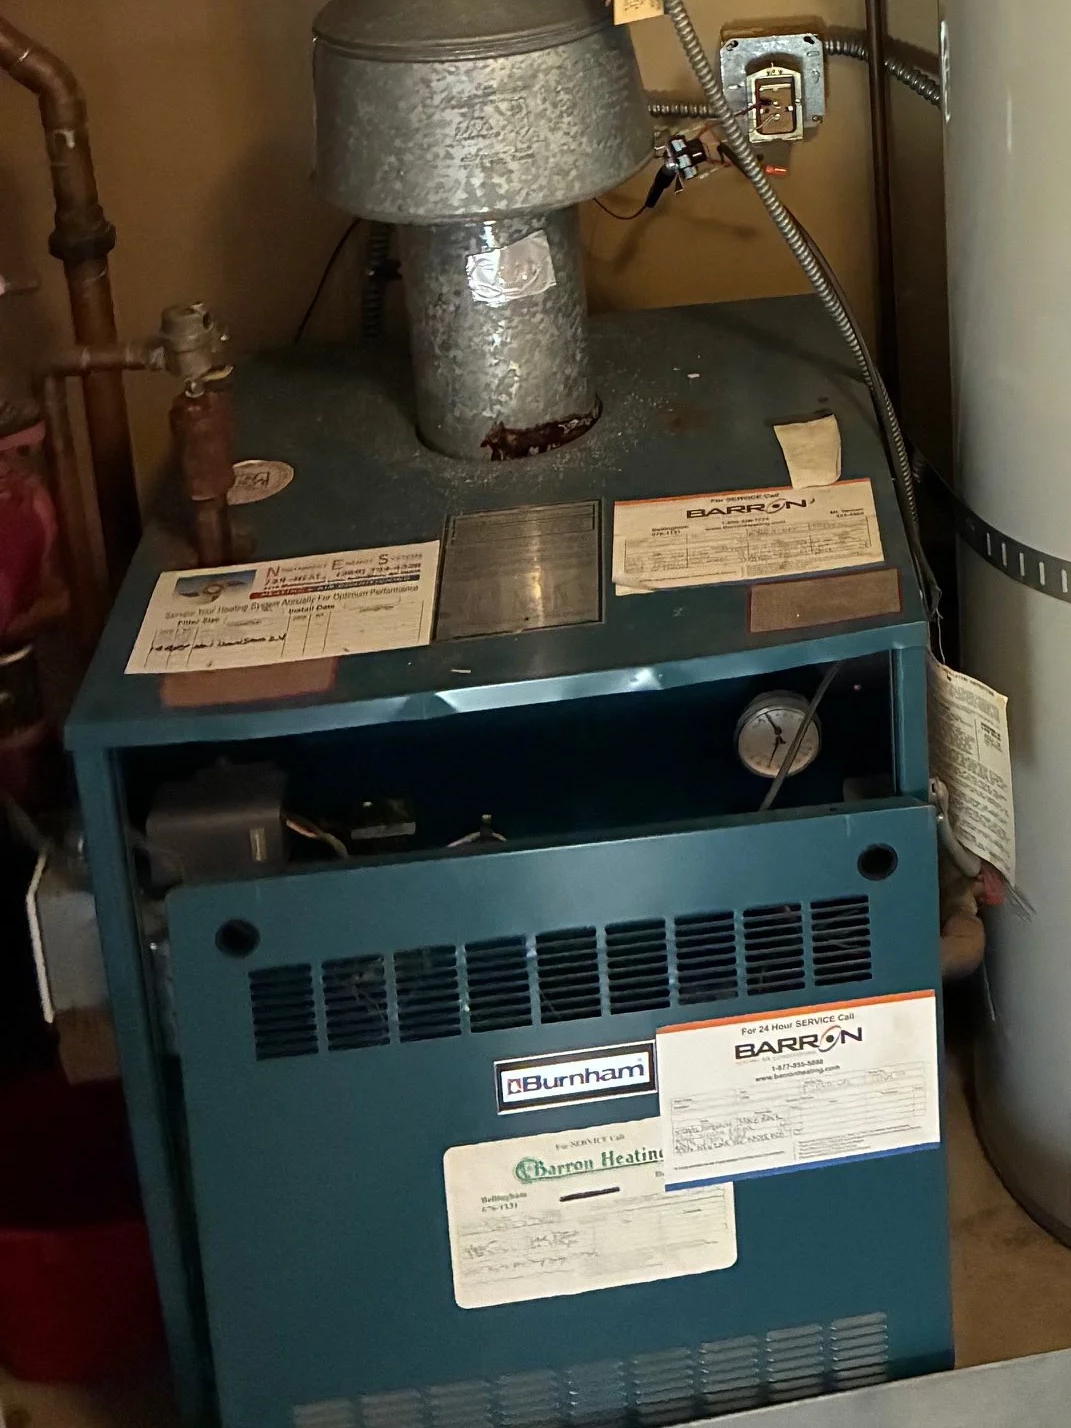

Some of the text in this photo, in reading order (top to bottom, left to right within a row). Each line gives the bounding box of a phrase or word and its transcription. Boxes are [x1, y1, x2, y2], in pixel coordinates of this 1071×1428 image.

[686, 498, 807, 519] BARRON
[741, 1012, 854, 1036] For 24 Hour SERVICE Call
[735, 1025, 862, 1060] BARRON
[523, 1061, 644, 1091] Burnham
[533, 1158, 593, 1176] Barron
